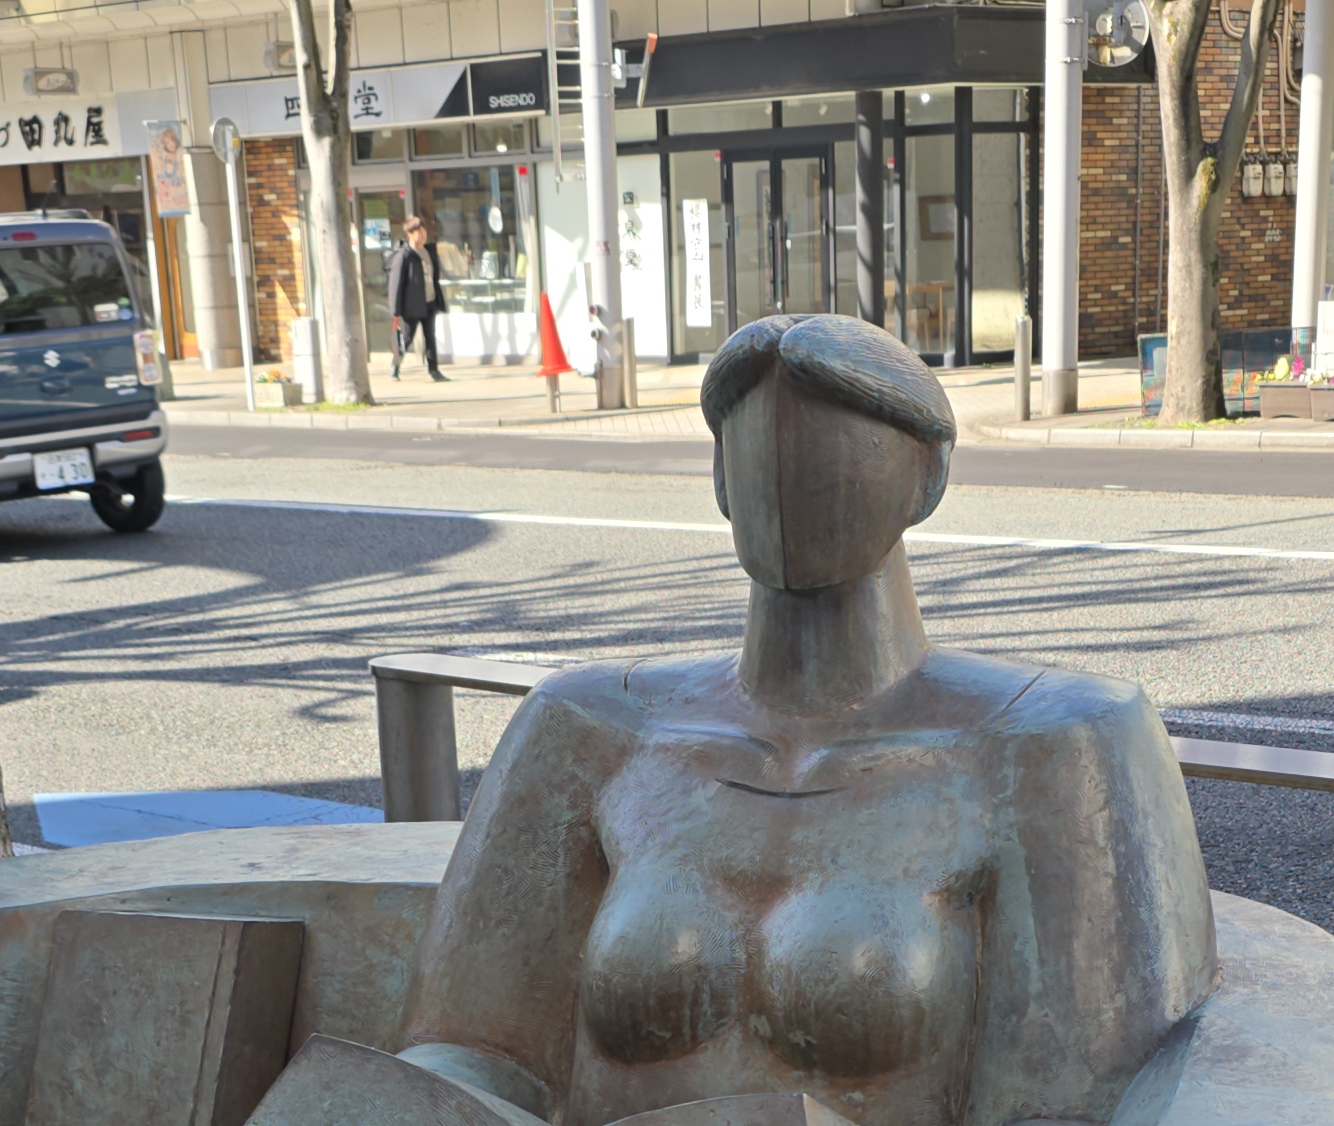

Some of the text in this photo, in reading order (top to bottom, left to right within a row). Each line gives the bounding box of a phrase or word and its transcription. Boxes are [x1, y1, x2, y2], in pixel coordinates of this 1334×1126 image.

[284, 80, 383, 120] 四堂
[489, 92, 536, 108] SHISENDO
[18, 106, 109, 151] 田丸屋
